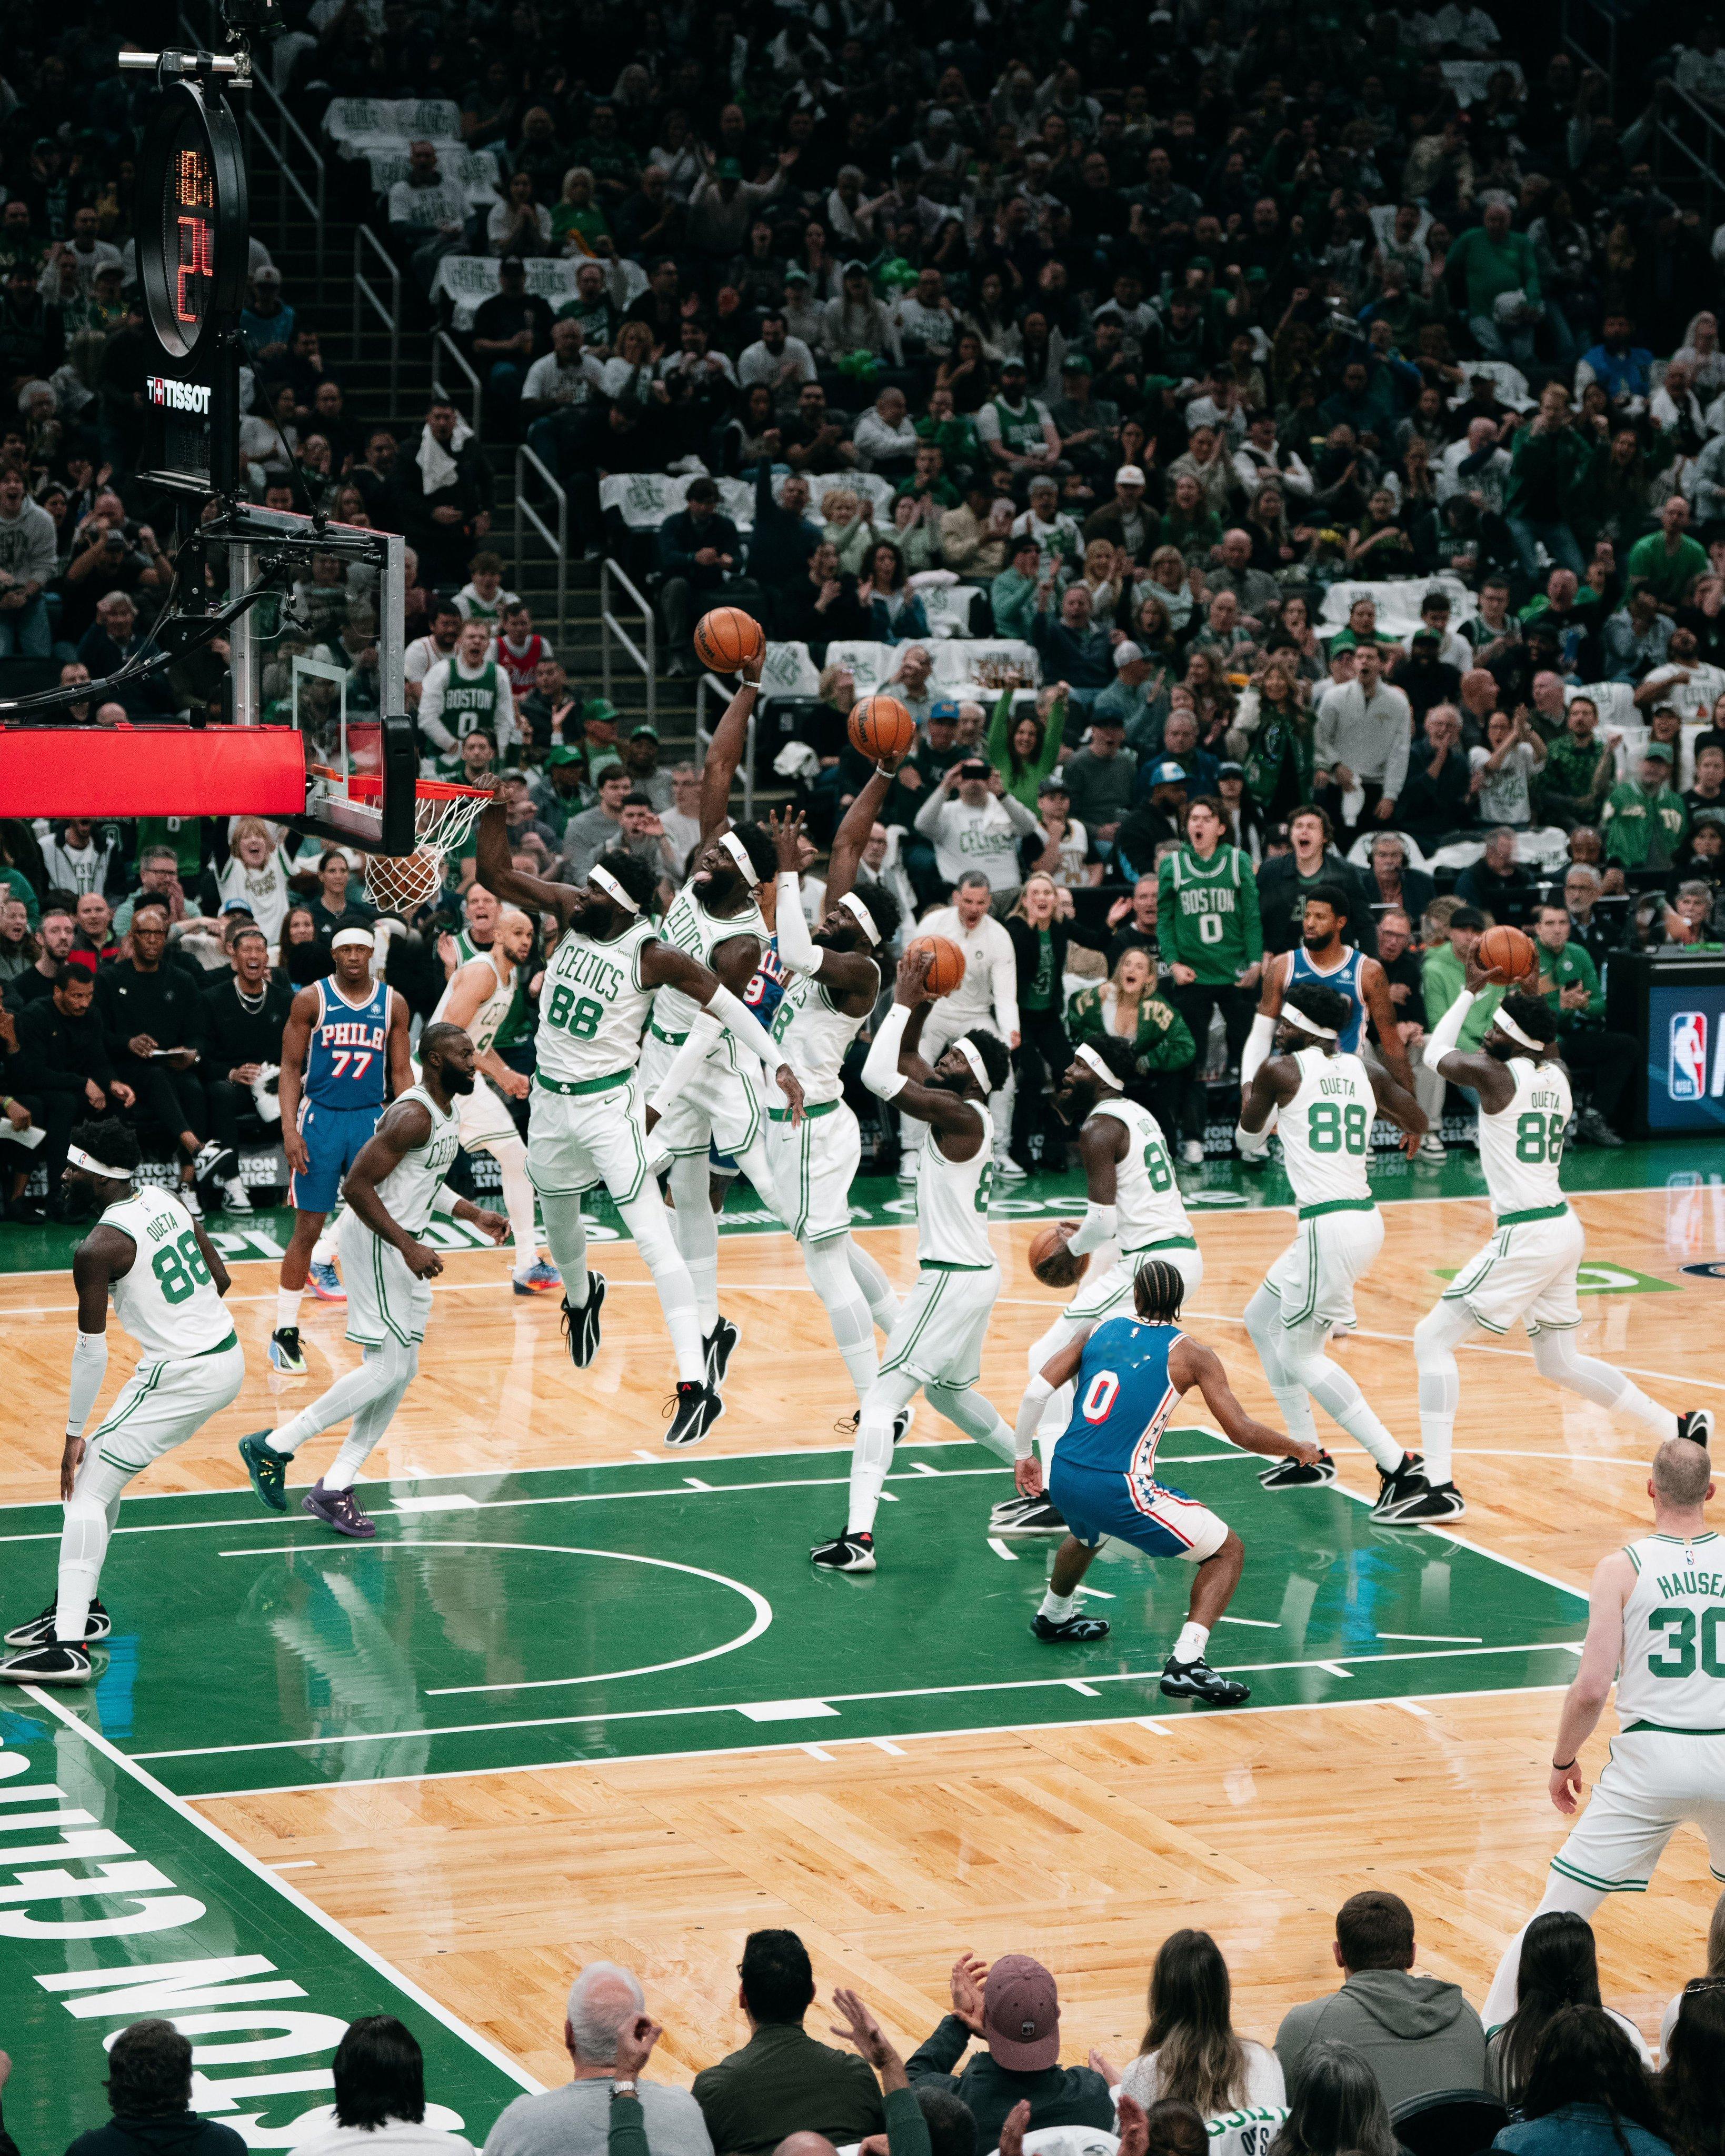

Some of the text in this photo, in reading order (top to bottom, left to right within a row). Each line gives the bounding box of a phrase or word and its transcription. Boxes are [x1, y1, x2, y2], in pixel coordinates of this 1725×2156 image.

[164, 378, 211, 415] TISSOT
[446, 688, 494, 711] BOSTON
[457, 711, 478, 738] 0
[1180, 888, 1235, 916] BOSTON
[666, 896, 703, 959] CELTICS
[1199, 914, 1224, 944] 0
[613, 947, 633, 959] Amica
[556, 945, 625, 1002] CELTICS
[743, 973, 767, 1006] 9
[547, 983, 604, 1042] 88
[321, 1022, 385, 1052] PHILA
[331, 1051, 373, 1080] 77
[1320, 1077, 1356, 1098] QUETA
[1531, 1091, 1561, 1112] QUETA
[1308, 1102, 1367, 1155] 88
[146, 1206, 180, 1243] QUETA
[152, 1229, 212, 1305] 88
[1082, 1370, 1121, 1426] 0
